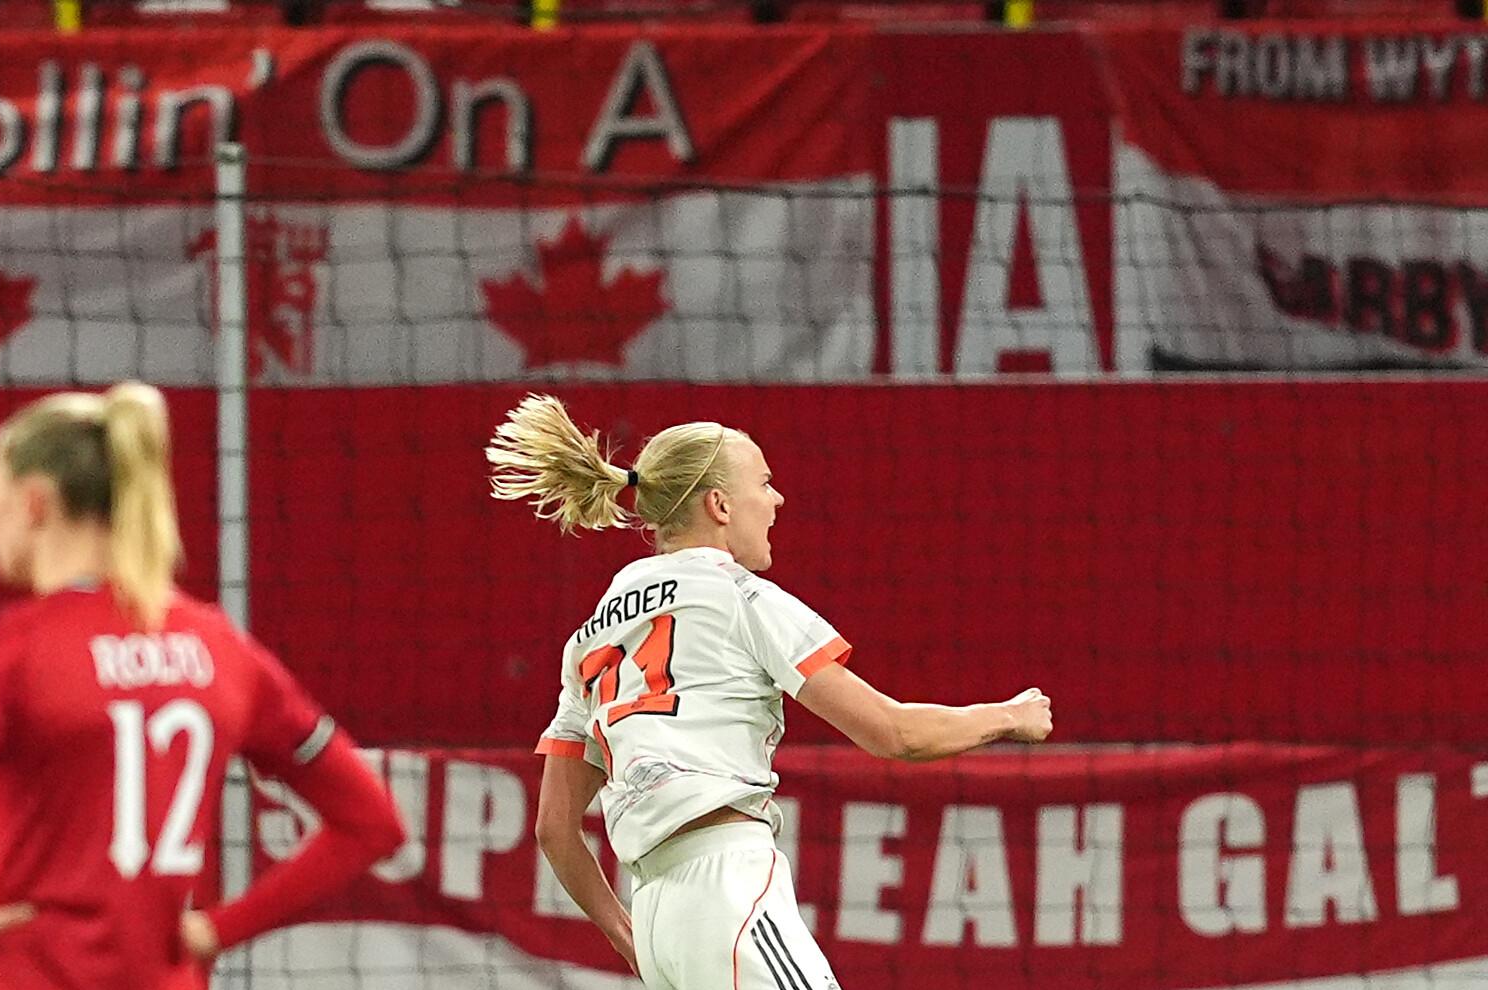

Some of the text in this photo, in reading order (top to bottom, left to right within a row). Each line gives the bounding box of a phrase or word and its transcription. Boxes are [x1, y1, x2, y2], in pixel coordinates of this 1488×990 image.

[319, 38, 533, 175] On
[581, 40, 699, 173] A
[1179, 25, 1349, 98] FROM
[106, 698, 215, 882] 12
[1176, 760, 1488, 938] GAL
